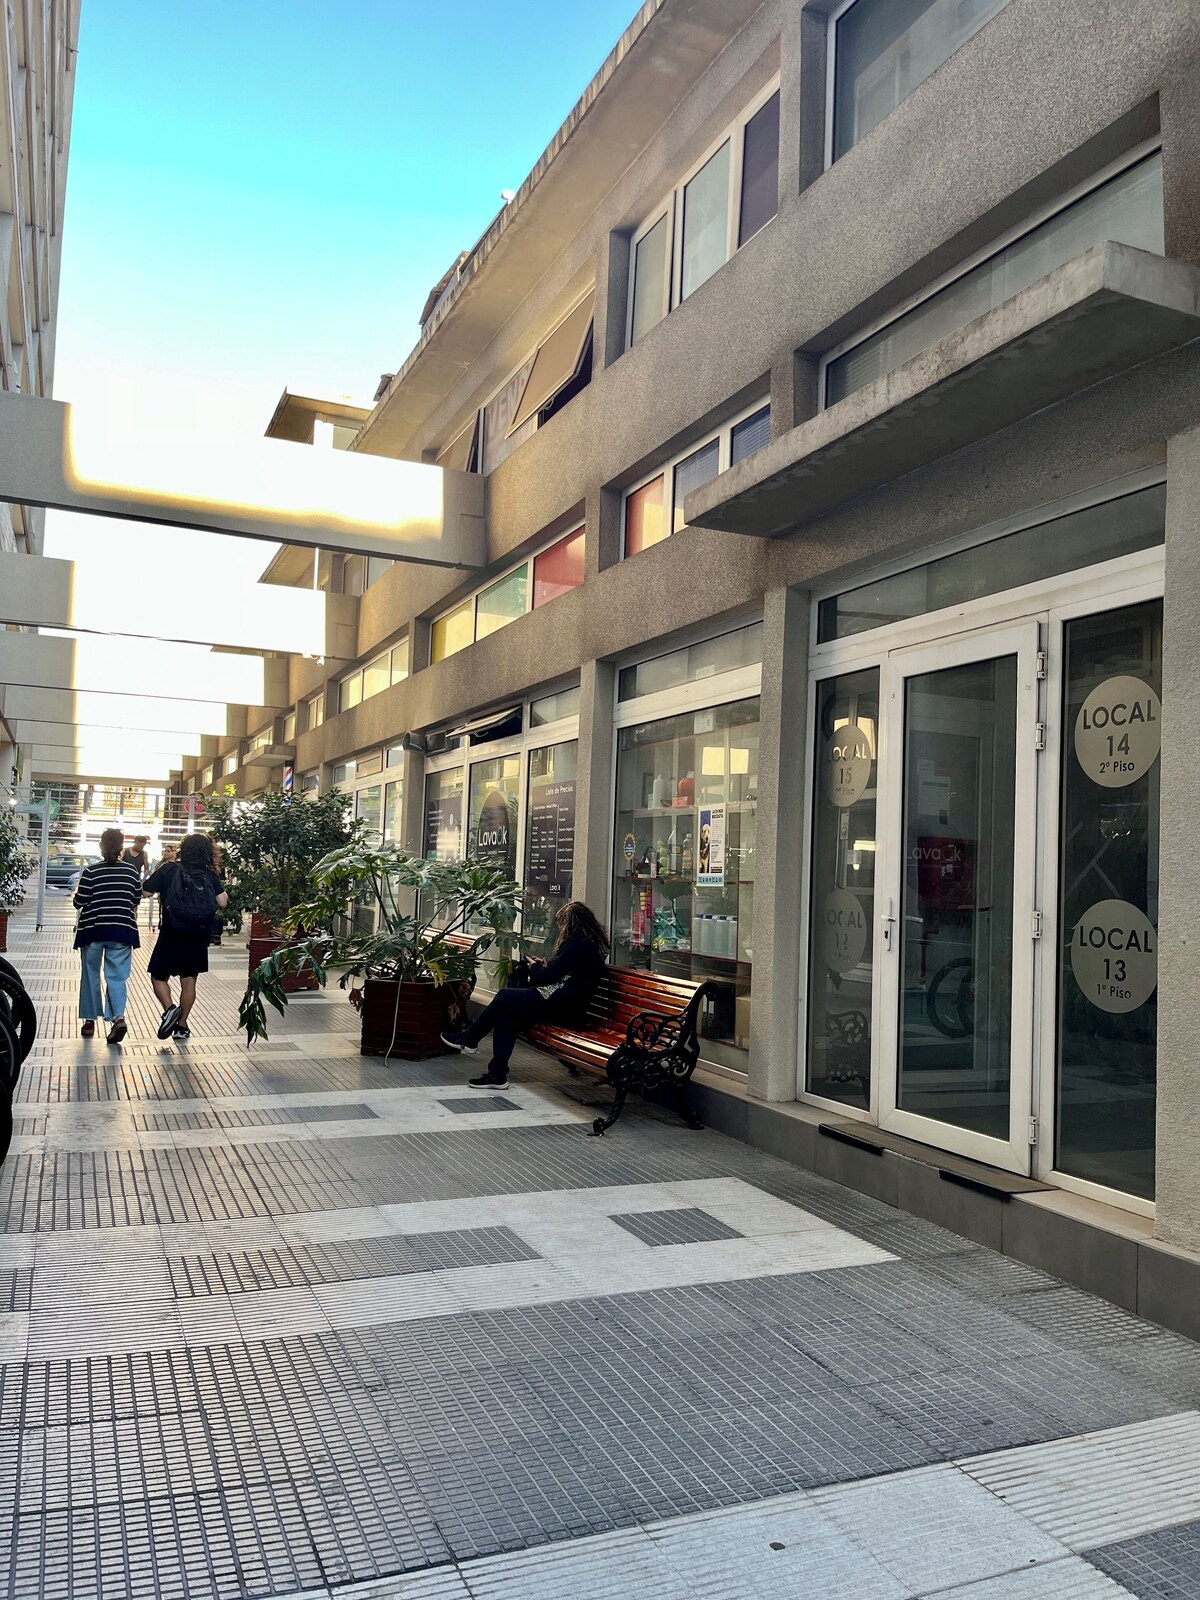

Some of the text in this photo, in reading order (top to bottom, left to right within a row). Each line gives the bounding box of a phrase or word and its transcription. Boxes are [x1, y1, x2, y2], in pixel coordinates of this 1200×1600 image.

[1083, 700, 1156, 730] LOCAL
[1106, 733, 1130, 757] 14
[839, 767, 852, 784] 15
[1113, 760, 1135, 773] Piso
[835, 932, 848, 950] 12
[1080, 925, 1153, 953] LOCAL
[1103, 958, 1127, 982] 13
[1110, 985, 1132, 1000] Piso
